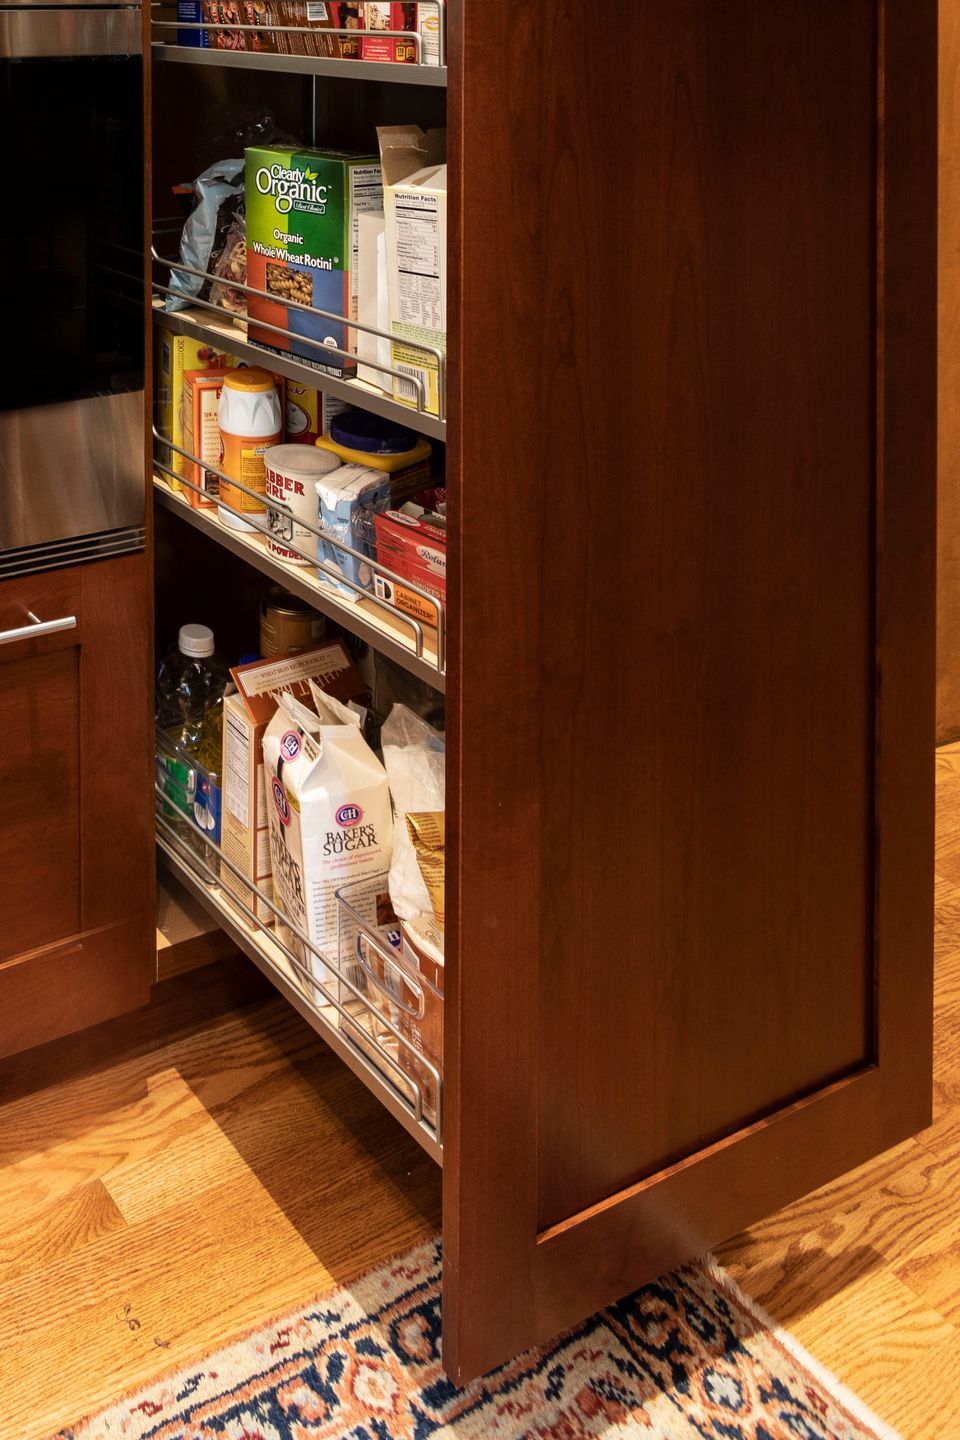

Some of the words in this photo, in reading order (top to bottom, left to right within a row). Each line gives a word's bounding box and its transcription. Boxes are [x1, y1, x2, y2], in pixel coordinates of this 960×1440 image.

[270, 164, 305, 184] Clearly
[256, 167, 327, 214] Organic
[395, 193, 419, 201] Nutrition
[421, 195, 436, 203] Facts
[273, 228, 304, 244] Organic
[253, 241, 276, 258] Whole
[275, 247, 304, 266] Wheat
[304, 253, 332, 271] Rotini
[177, 339, 185, 353] 200
[266, 467, 305, 497] ABBER
[272, 543, 303, 561] POWDE
[421, 549, 445, 567] Rolan
[396, 589, 421, 607] CABINET
[260, 668, 277, 679] WHEAT
[277, 665, 290, 674] BRAN
[339, 807, 358, 821] C&H
[325, 823, 375, 845] BAKER'S
[323, 834, 378, 857] SUGAR
[330, 860, 358, 871] professional
[332, 856, 348, 864] choice
